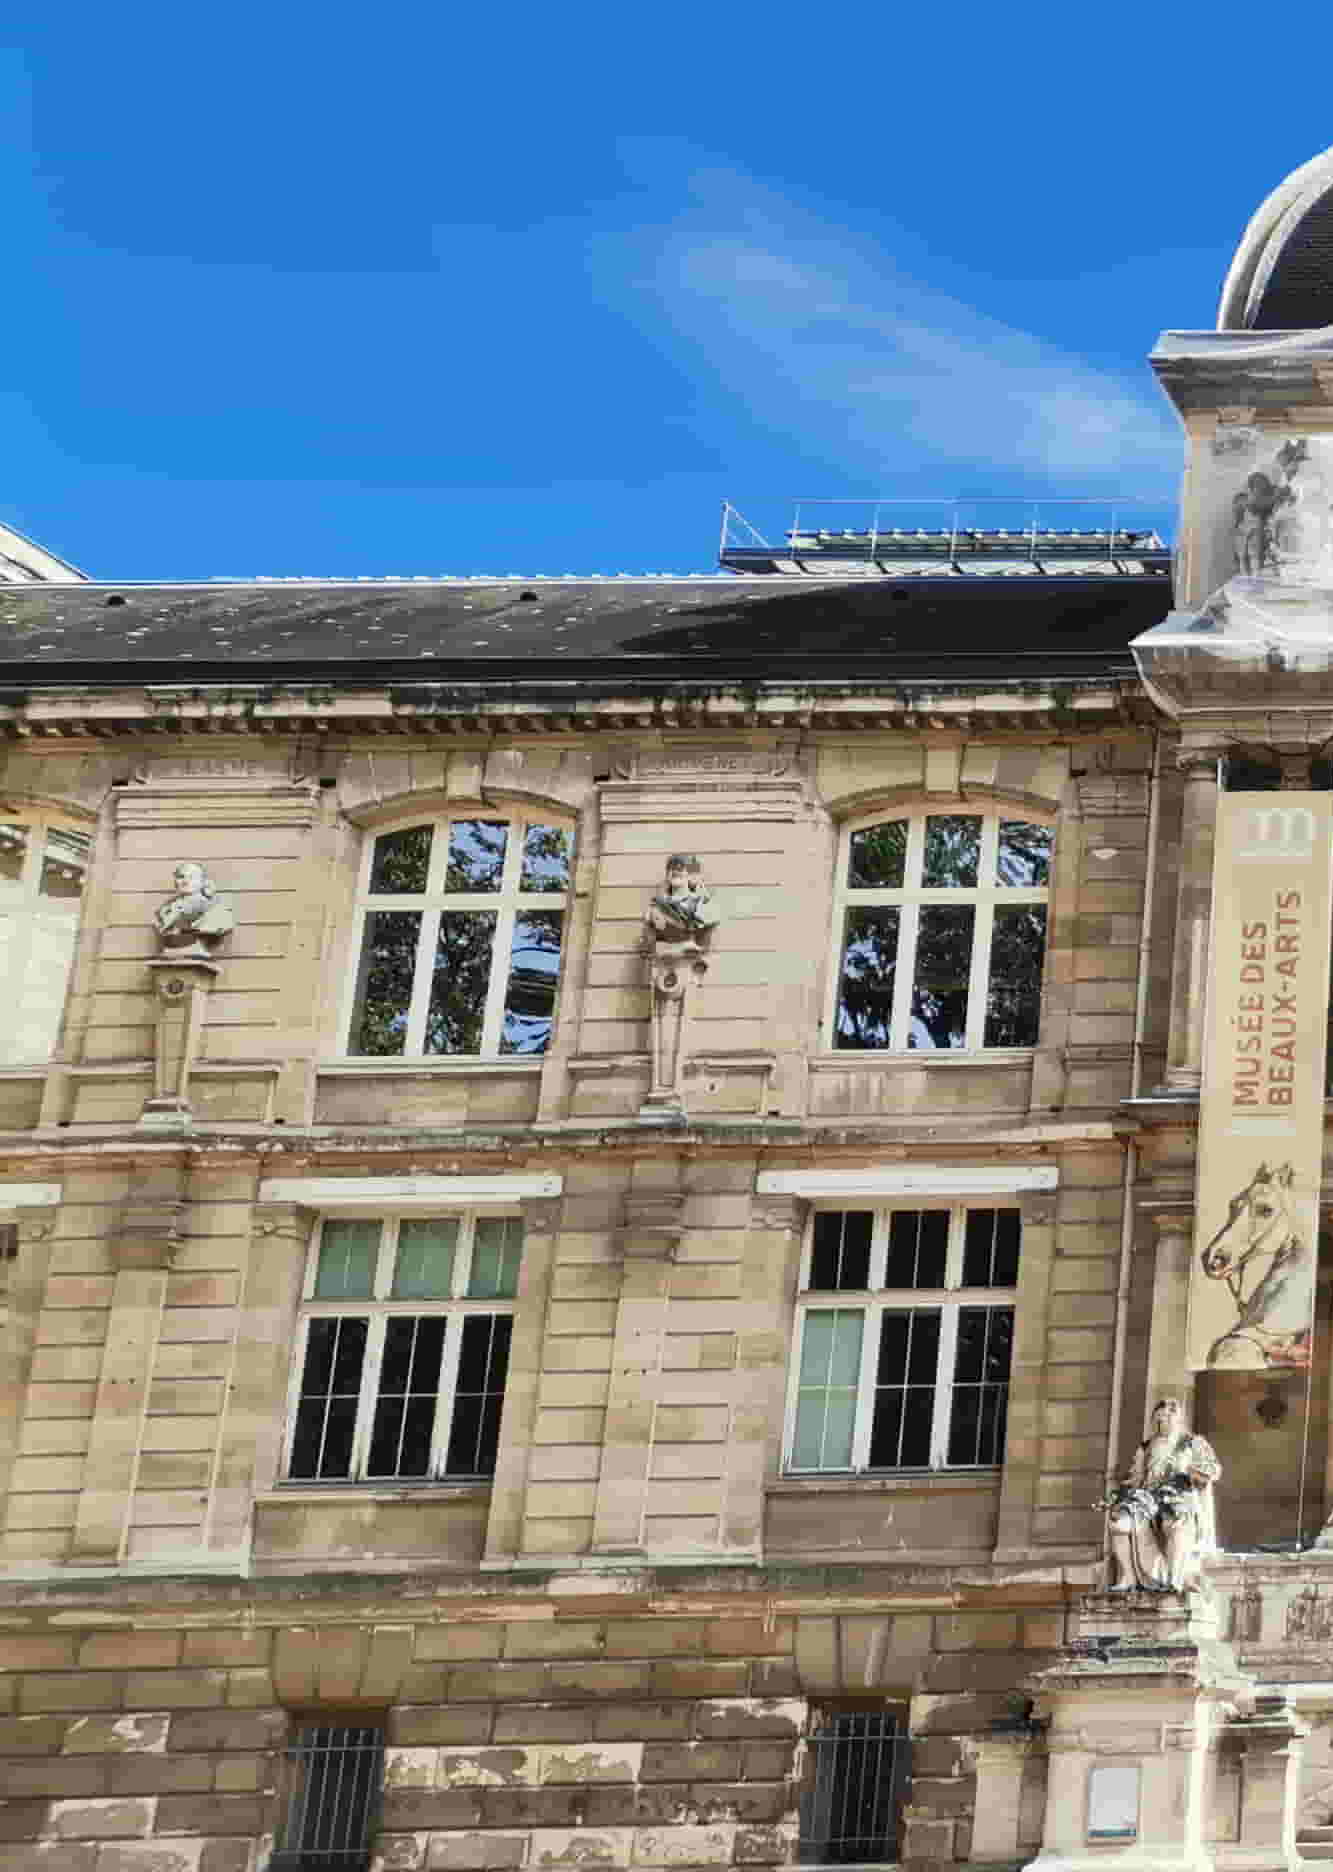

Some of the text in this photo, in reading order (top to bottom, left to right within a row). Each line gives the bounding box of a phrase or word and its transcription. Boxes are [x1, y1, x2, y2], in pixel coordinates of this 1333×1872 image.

[1240, 921, 1267, 984] DES
[1267, 887, 1301, 1105] BEAUX-ARTS
[1231, 992, 1265, 1105] MUSÉE
